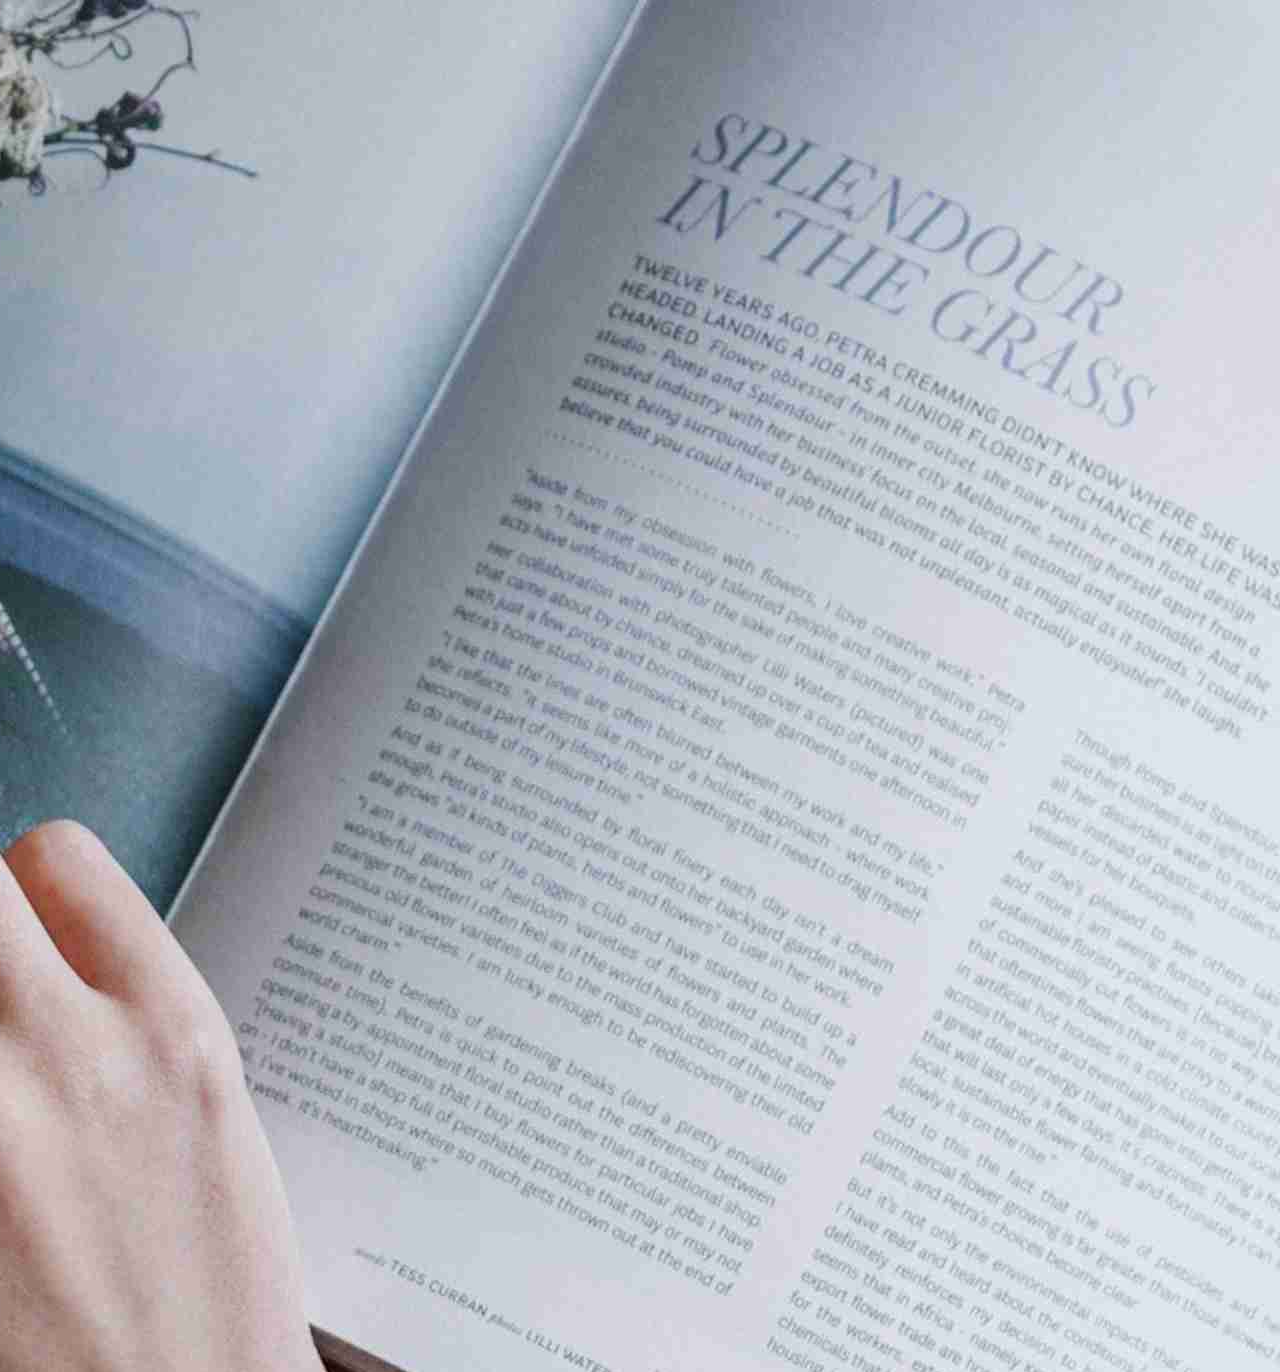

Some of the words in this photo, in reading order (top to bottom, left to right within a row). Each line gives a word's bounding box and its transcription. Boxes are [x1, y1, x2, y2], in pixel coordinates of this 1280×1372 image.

[656, 174, 761, 244] IN
[760, 206, 928, 317] THE
[930, 286, 1158, 429] GRASS
[689, 112, 1124, 336] SPLENDOUR
[582, 352, 653, 384] crowded
[654, 375, 723, 417] industry
[728, 408, 765, 430] with
[765, 420, 792, 443] her
[869, 469, 913, 501] focus
[915, 495, 937, 513] on
[939, 505, 966, 528] the
[1013, 545, 1082, 588] seasonal
[1082, 583, 1114, 606] and
[1244, 671, 1270, 692] she
[632, 253, 708, 293] TWELVE
[710, 284, 775, 320] YEARS
[825, 331, 890, 370] PETRA
[891, 361, 1000, 423] CREMMING
[1002, 415, 1064, 457] DIDN'T
[1066, 448, 1127, 491] KNOW
[1128, 482, 1198, 530] WHERE
[1199, 521, 1238, 551] SHE
[1239, 542, 1280, 574] WAS
[634, 396, 681, 429] being
[683, 419, 778, 466] surrounded
[779, 456, 799, 480] by
[802, 467, 878, 512] beautiful
[878, 503, 936, 542] blooms
[938, 537, 962, 555] all
[963, 546, 993, 576] day
[997, 564, 1009, 580] is
[1011, 575, 1031, 592] as
[1033, 586, 1098, 628] magical
[1097, 621, 1115, 638] as
[1118, 629, 1131, 646] it
[660, 350, 707, 383] Pomp
[710, 372, 744, 393] and
[746, 384, 835, 434] Splendour
[848, 430, 867, 449] in
[869, 440, 914, 472] inner
[917, 466, 948, 493] city
[1046, 533, 1102, 574] setting
[1105, 561, 1162, 602] herself
[1161, 595, 1206, 626] apart
[1208, 618, 1247, 650] from
[702, 310, 789, 355] LANDING
[809, 353, 845, 379] JOB
[847, 370, 875, 393] AS
[894, 392, 964, 435] JUNIOR
[967, 427, 1045, 477] FLORIST
[1048, 469, 1075, 493] BY
[1158, 529, 1197, 559] HER
[1200, 552, 1241, 583] LIFE
[1243, 575, 1280, 606] WAS
[707, 339, 766, 375] Flower
[769, 369, 845, 409] obsessed
[848, 401, 889, 431] from
[892, 423, 920, 445] the
[981, 469, 1010, 491] she
[1013, 485, 1049, 512] now
[1050, 505, 1087, 532] runs
[1089, 523, 1116, 548] her
[1119, 542, 1154, 568] own
[1156, 560, 1201, 594] floral
[1202, 585, 1256, 625] design
[500, 622, 544, 650] home
[595, 662, 610, 679] in
[612, 669, 689, 714] Brunswick
[558, 395, 613, 426] believe
[616, 418, 651, 441] that
[649, 434, 682, 454] you
[684, 447, 732, 474] could
[733, 465, 771, 492] have
[785, 489, 816, 513] job
[816, 504, 852, 530] that
[853, 524, 885, 547] was
[887, 541, 917, 562] not
[1012, 606, 1077, 651] actually
[1163, 688, 1190, 709] she
[343, 820, 416, 856] wonderful
[419, 852, 473, 882] garden
[478, 878, 498, 892] of
[501, 884, 568, 926] heirloom
[573, 922, 639, 960] varieties
[644, 957, 663, 972] of
[666, 964, 719, 1002] flowers
[726, 998, 757, 1020] and
[820, 1043, 847, 1067] The
[389, 1261, 426, 1286] TESS
[428, 1280, 488, 1317] CURRAN
[525, 1329, 560, 1354] LILLI
[912, 1179, 941, 1200] and
[990, 1221, 1044, 1258] choices
[1046, 1249, 1101, 1290] become
